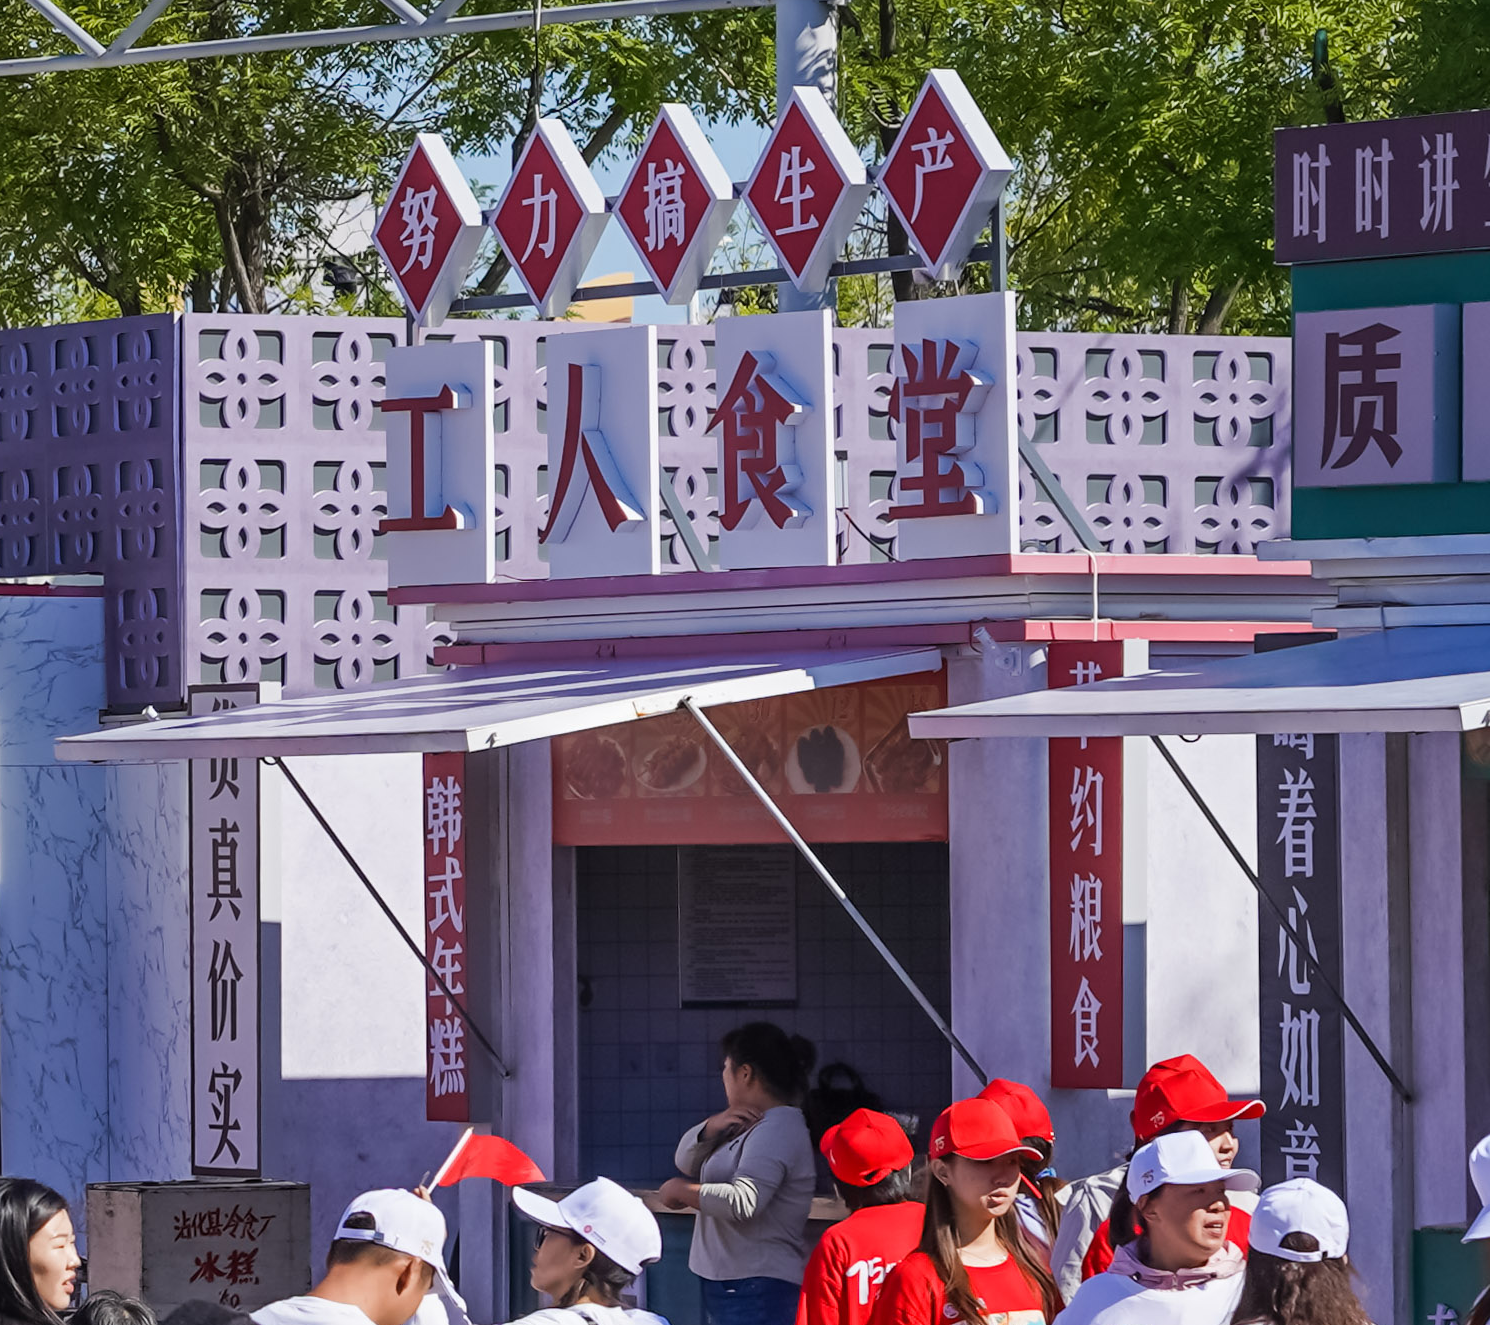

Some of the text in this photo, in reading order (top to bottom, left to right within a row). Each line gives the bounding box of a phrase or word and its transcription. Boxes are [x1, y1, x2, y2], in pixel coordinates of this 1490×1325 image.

[399, 127, 956, 276] 努力搞生产
[1292, 133, 1490, 244] 时时讲
[378, 339, 981, 544] 工人食堂
[1320, 322, 1403, 470] 质
[424, 776, 466, 1099] 韩式年糕
[190, 1248, 259, 1286] 冰糕
